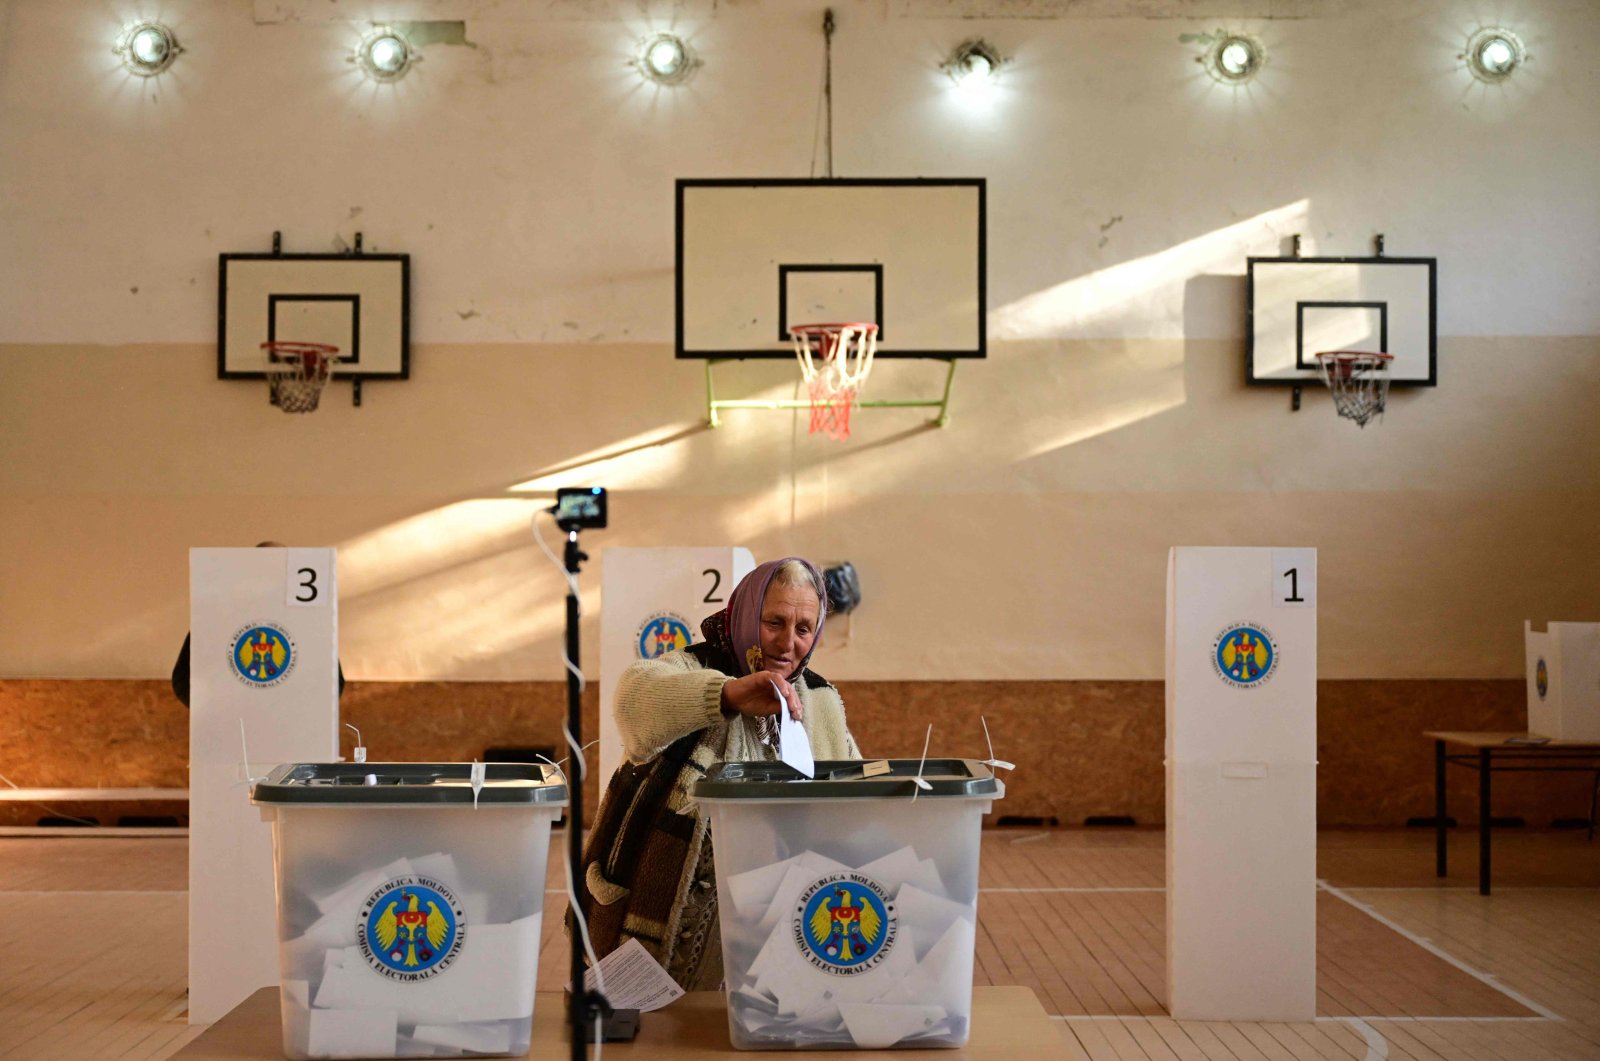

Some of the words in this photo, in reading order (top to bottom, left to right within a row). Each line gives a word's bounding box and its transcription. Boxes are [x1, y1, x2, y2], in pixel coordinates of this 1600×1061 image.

[296, 568, 318, 602] 3
[702, 569, 723, 603] 2
[1284, 568, 1304, 602] 1
[366, 878, 413, 908] REPUBLICA
[417, 878, 457, 907] MOLDOVA
[801, 874, 846, 903] REPUBLICA
[850, 874, 889, 903] MOLDOVA
[358, 923, 374, 964] COMISIA
[374, 963, 438, 982] ELECTORALĂ
[440, 922, 465, 970] CENTRALĂ
[794, 918, 810, 958] COMISIA
[811, 957, 872, 975] ELECTORALĂ
